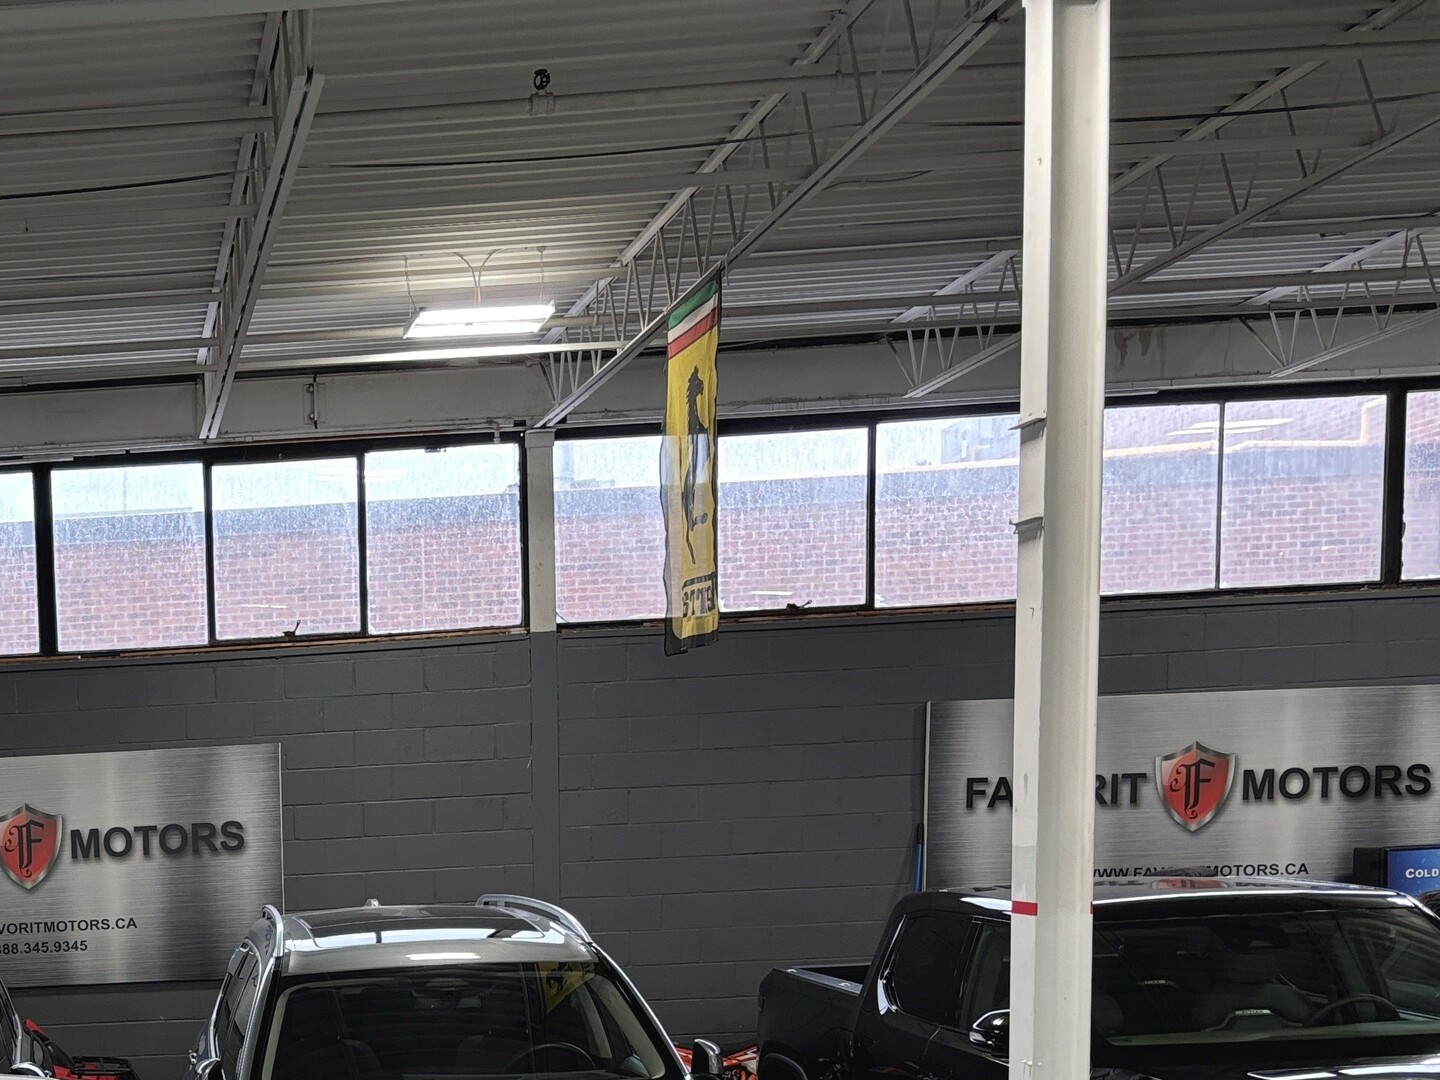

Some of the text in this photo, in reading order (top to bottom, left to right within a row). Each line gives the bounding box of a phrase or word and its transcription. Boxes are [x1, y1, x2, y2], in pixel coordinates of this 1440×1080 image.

[966, 772, 1147, 809] FAIT
[1242, 763, 1432, 801] MOTORS
[70, 820, 245, 860] MOTORS
[1405, 868, 1440, 879] COLD
